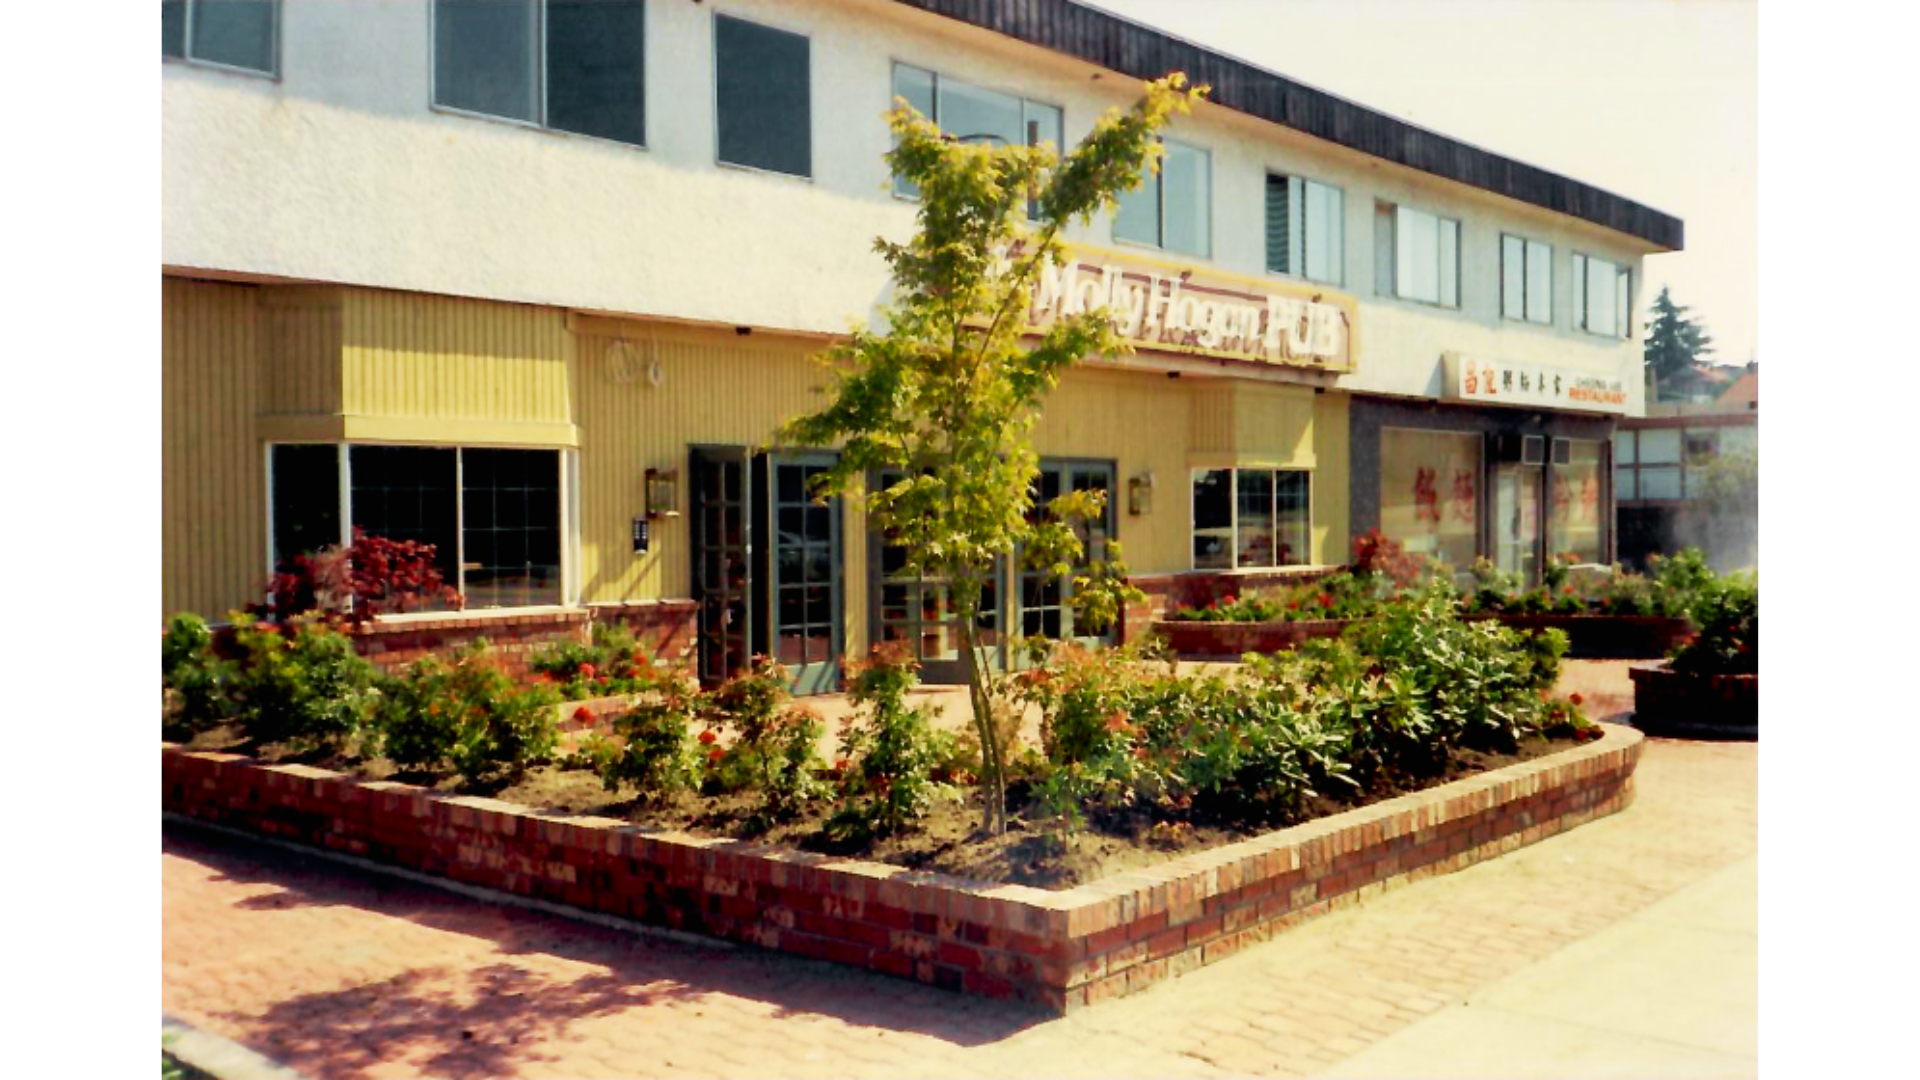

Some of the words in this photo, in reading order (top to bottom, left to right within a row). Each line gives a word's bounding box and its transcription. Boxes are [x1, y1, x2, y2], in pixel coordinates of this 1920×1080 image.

[1036, 252, 1143, 335] Molly
[1146, 273, 1261, 347] Hogan
[1263, 295, 1341, 356] PUB
[1568, 387, 1627, 405] RESTAURANT
